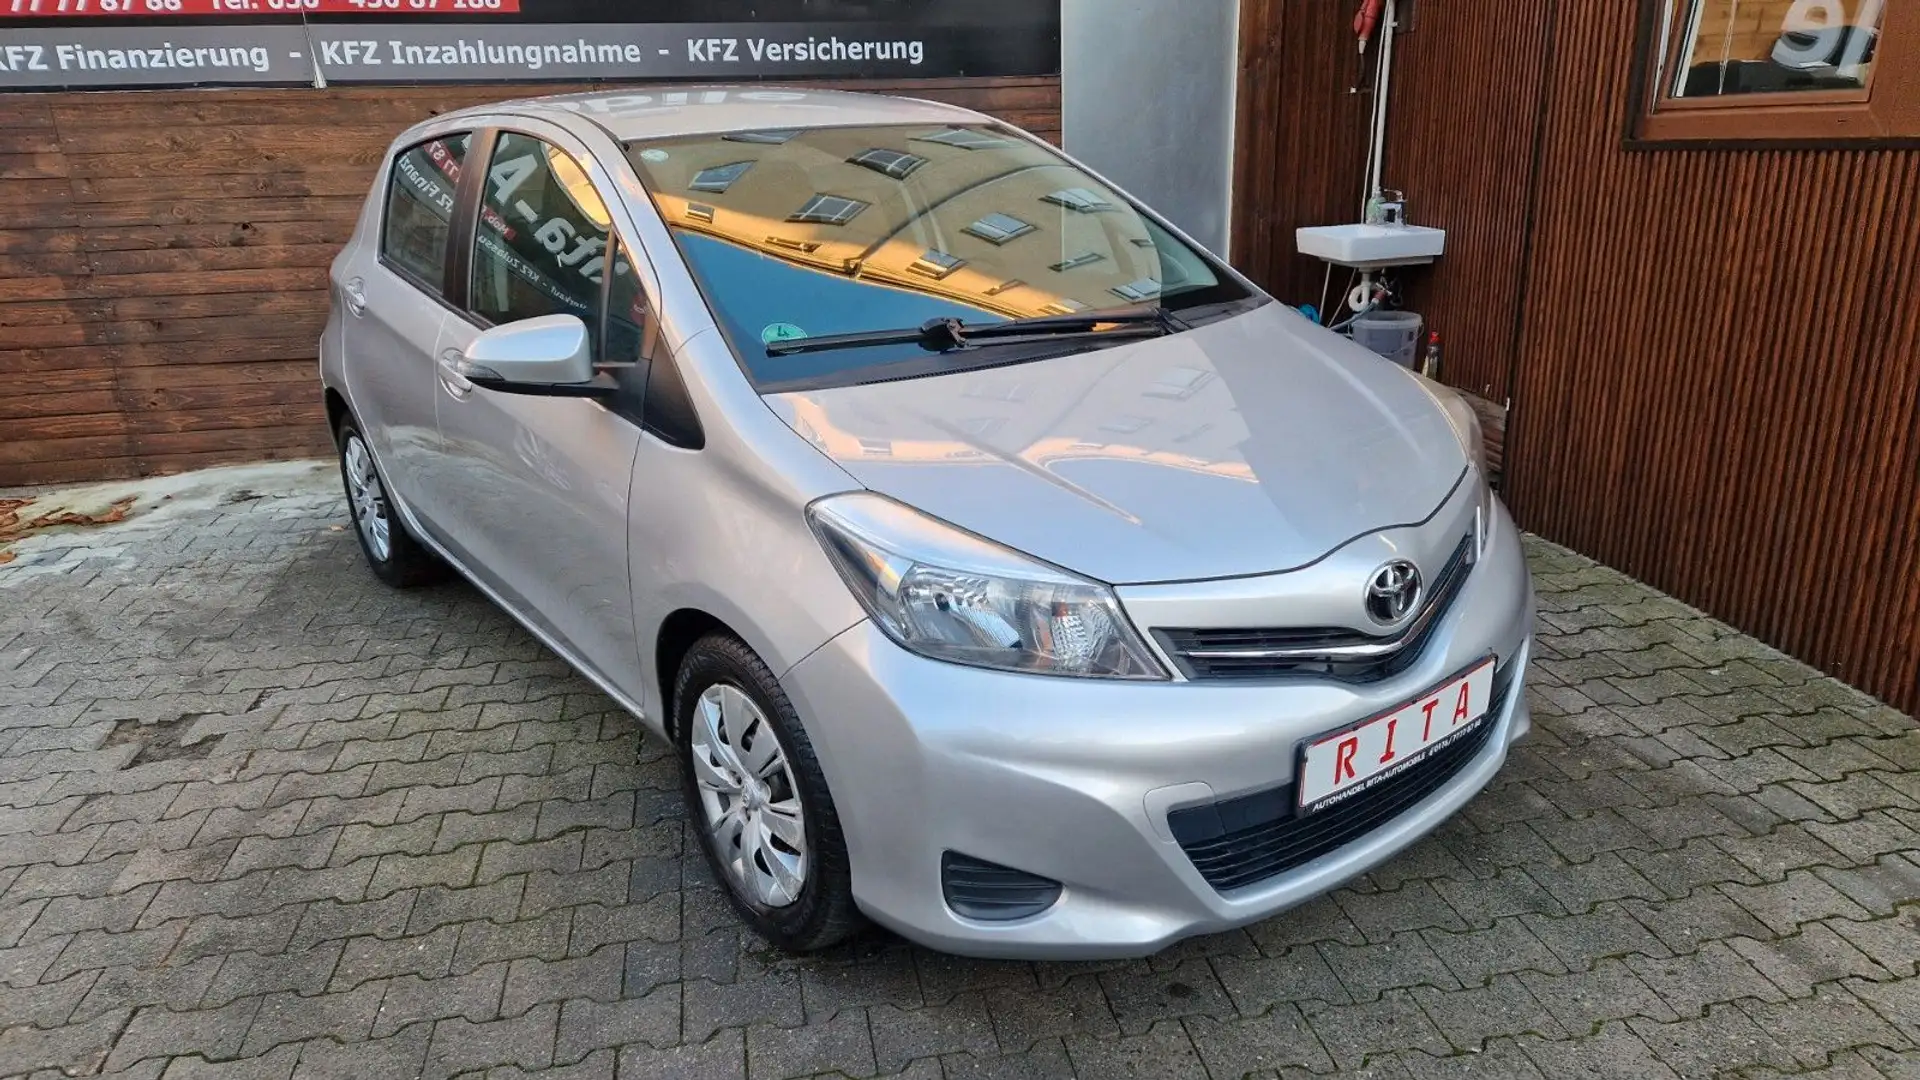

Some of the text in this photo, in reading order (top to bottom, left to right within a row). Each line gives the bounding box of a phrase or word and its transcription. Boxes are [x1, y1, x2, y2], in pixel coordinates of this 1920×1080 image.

[56, 42, 270, 72] Finanzierung
[320, 40, 382, 66] KFZ
[388, 38, 641, 70] Inzahlungnahme
[687, 38, 740, 62] KFZ
[745, 36, 924, 65] Versicherung
[1312, 783, 1366, 813] AUTOHANDEL
